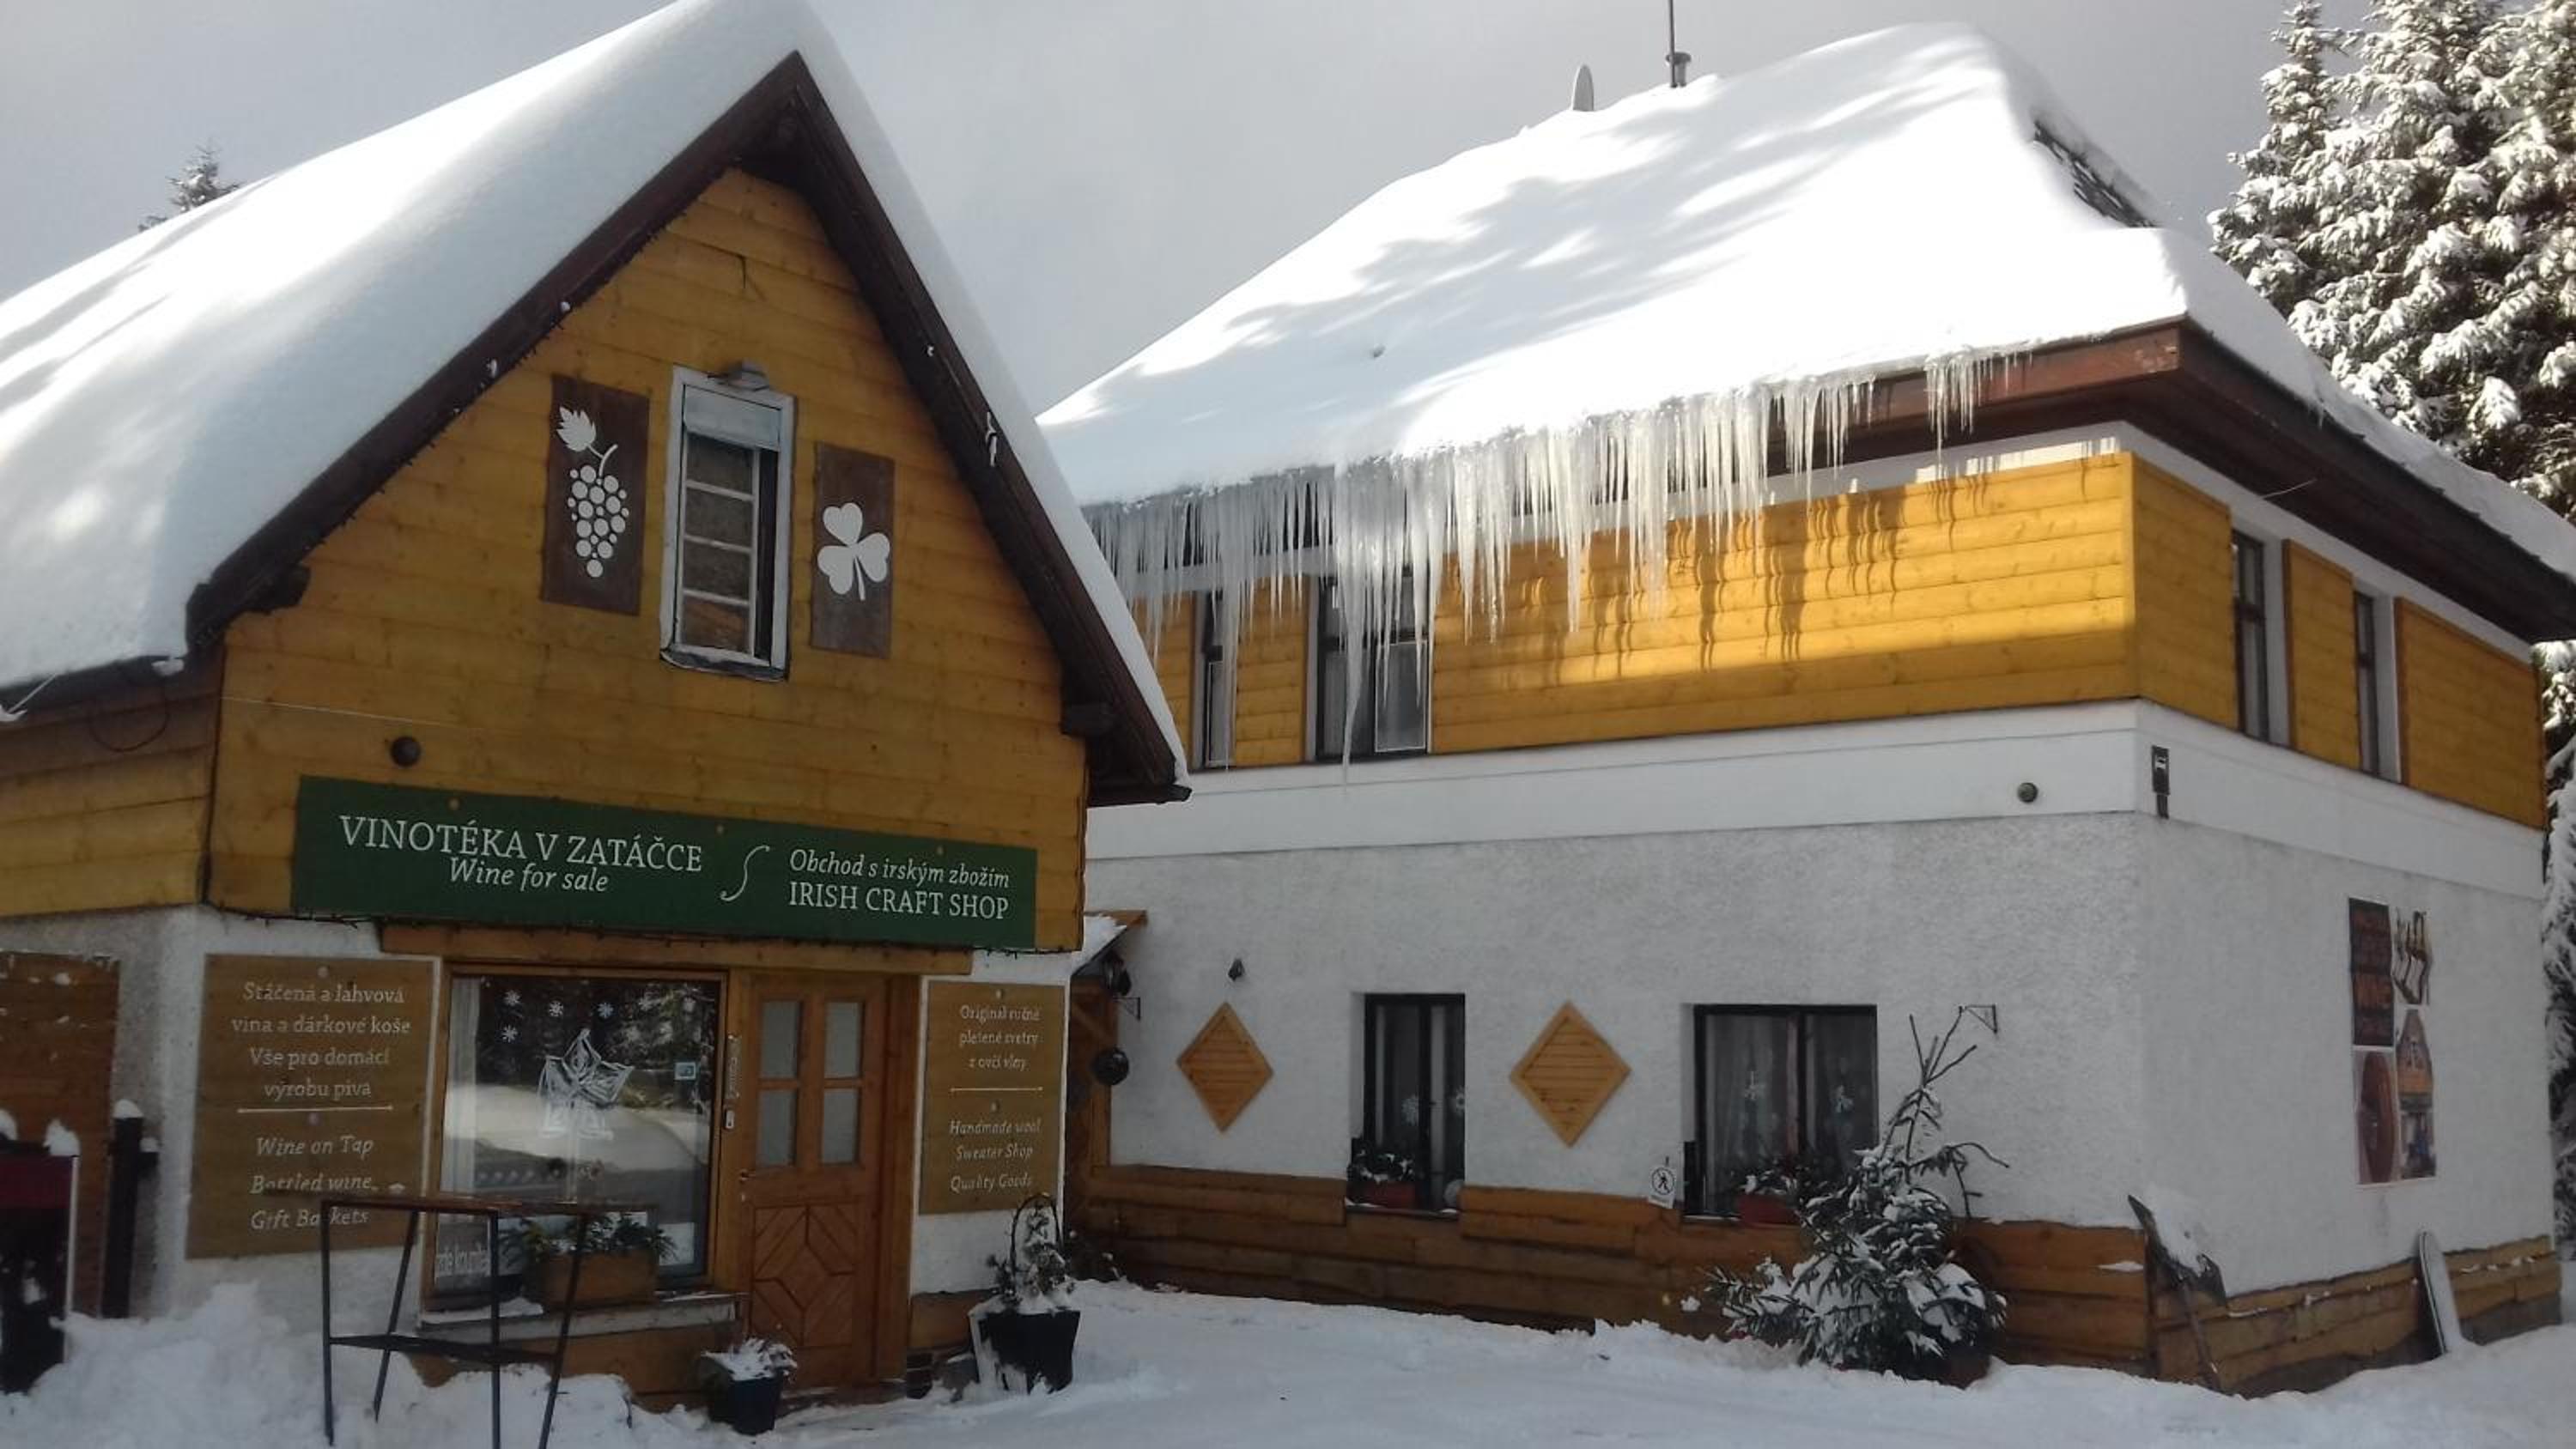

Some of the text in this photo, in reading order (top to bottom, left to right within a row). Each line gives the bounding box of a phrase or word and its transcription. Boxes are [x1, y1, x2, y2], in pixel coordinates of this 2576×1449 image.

[340, 815, 702, 872] VINOTÉKA V ZATÁČCE
[449, 858, 609, 892] Wine for sale
[789, 848, 1009, 889] Obchod s irským zbožím
[789, 881, 1009, 919] IRISH CRAFT SHOP
[243, 981, 404, 1003] Stáčená a lahvová
[276, 1019, 288, 1033] a
[295, 1015, 366, 1034] dárkové
[370, 1016, 411, 1034] koše
[959, 1004, 1006, 1025] Original
[249, 1046, 389, 1070] Vše pro domácí
[264, 1077, 371, 1100] výrobu piva
[950, 1119, 1012, 1135] Handmade
[257, 1135, 374, 1158] Wine on Tap
[956, 1143, 1033, 1161] Sweater Shop
[951, 1174, 995, 1193] Quality
[251, 1206, 369, 1230] Gift Bakets
